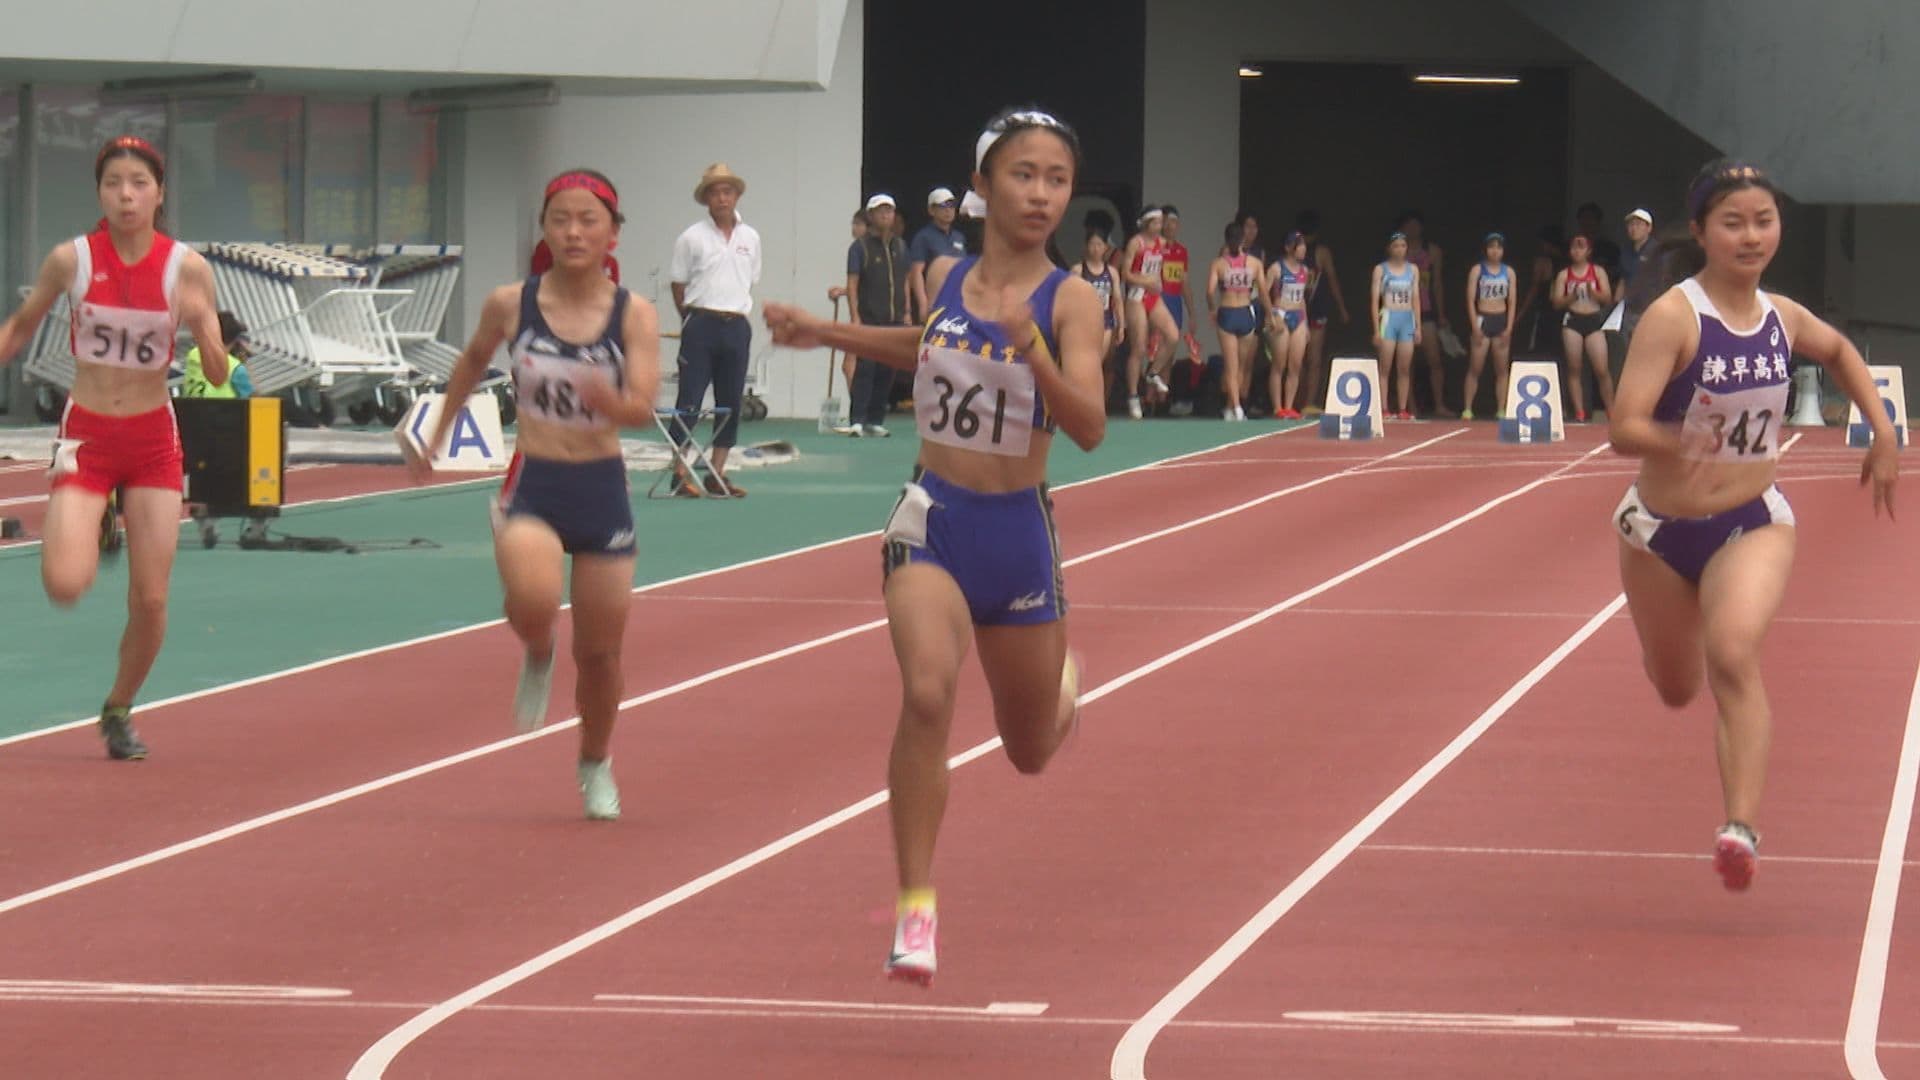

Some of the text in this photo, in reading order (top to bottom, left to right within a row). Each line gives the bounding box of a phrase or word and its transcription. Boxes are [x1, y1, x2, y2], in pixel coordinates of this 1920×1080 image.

[92, 324, 157, 365] 516
[929, 375, 1007, 444] 361
[1336, 371, 1371, 418] 9
[1516, 375, 1551, 425] 8
[448, 405, 493, 458] A
[1707, 408, 1774, 456] 342
[1619, 505, 1639, 536] 6
